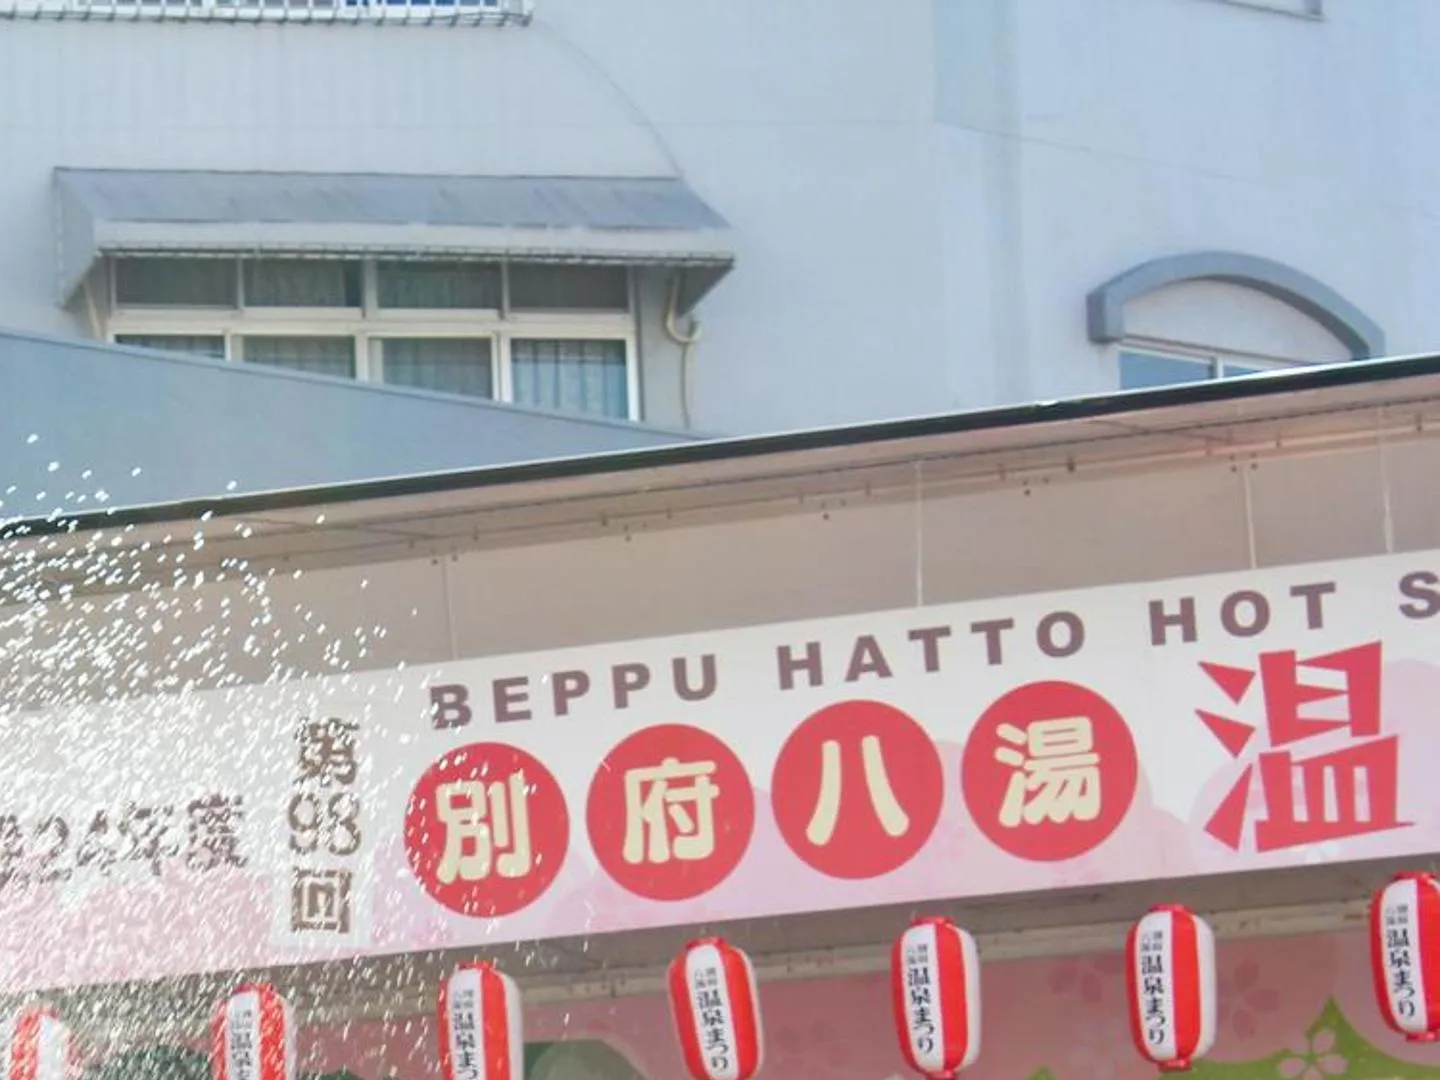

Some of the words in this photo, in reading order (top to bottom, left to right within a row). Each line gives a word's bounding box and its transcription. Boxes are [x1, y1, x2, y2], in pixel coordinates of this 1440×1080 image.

[428, 655, 720, 731] BEPPU
[776, 611, 1087, 691] HATTO
[1148, 581, 1338, 646] HOT
[435, 716, 1105, 886] 別府八湯
[1193, 640, 1417, 853] 温
